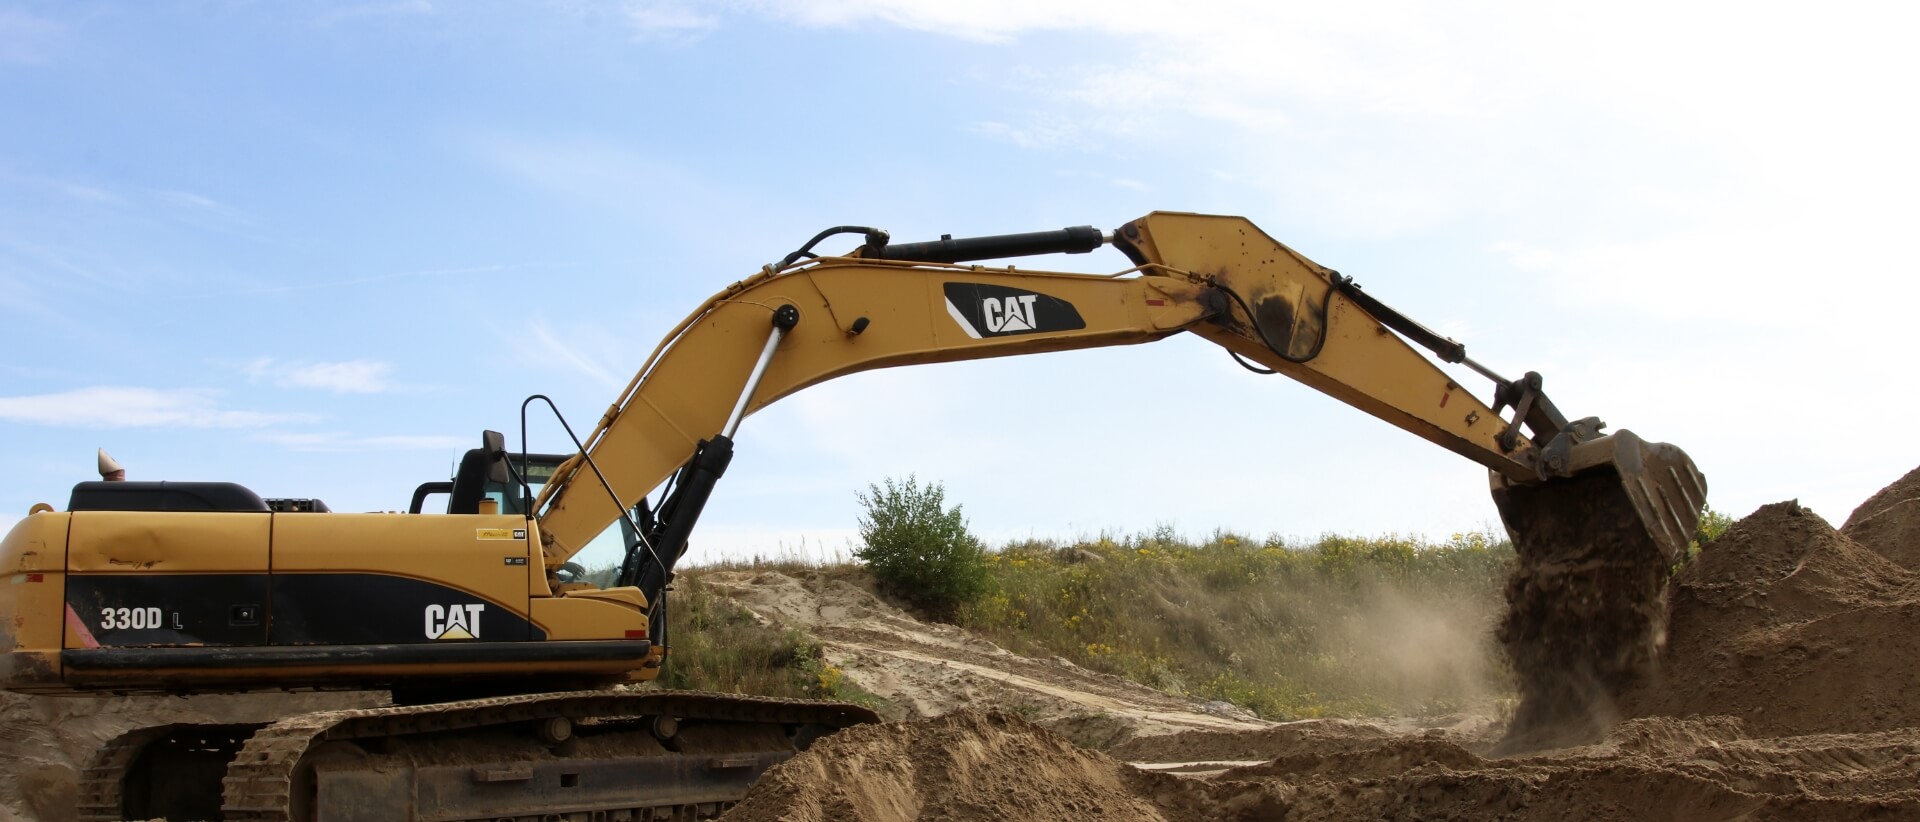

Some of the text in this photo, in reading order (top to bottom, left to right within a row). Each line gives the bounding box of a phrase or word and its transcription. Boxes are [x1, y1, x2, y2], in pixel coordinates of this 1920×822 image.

[983, 294, 1037, 333] CAT
[100, 607, 184, 630] 330D L
[424, 603, 485, 640] CAT
